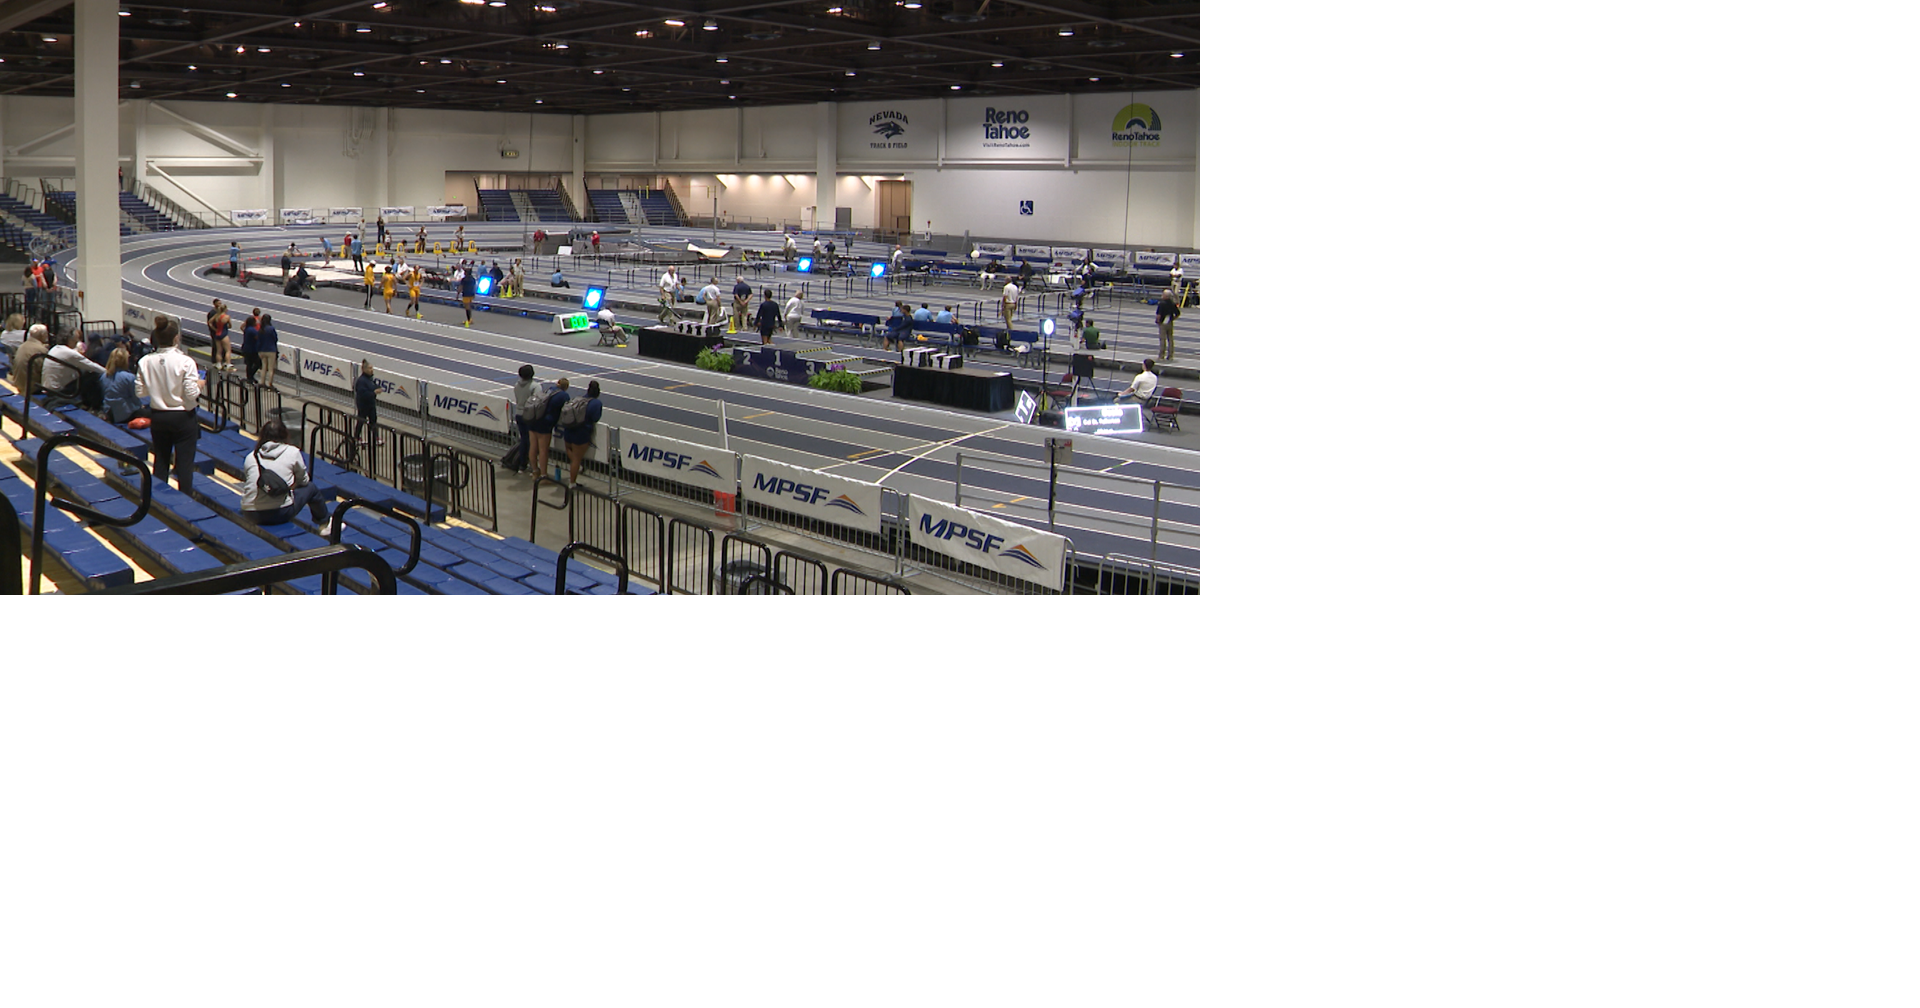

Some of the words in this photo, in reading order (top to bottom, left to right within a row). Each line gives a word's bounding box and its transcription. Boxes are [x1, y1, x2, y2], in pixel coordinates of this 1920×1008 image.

[869, 110, 909, 125] NEVADA
[985, 106, 1029, 124] Reno
[982, 123, 1030, 139] Tahoe
[1112, 132, 1160, 141] RenoTahoe
[743, 352, 751, 365] 2
[774, 350, 782, 366] 1
[304, 359, 333, 376] MPSF
[806, 361, 815, 375] 3
[433, 394, 479, 415] MPSF
[628, 443, 692, 470] MPSF
[753, 472, 830, 504] MPSF
[919, 513, 1005, 553] MPSF
